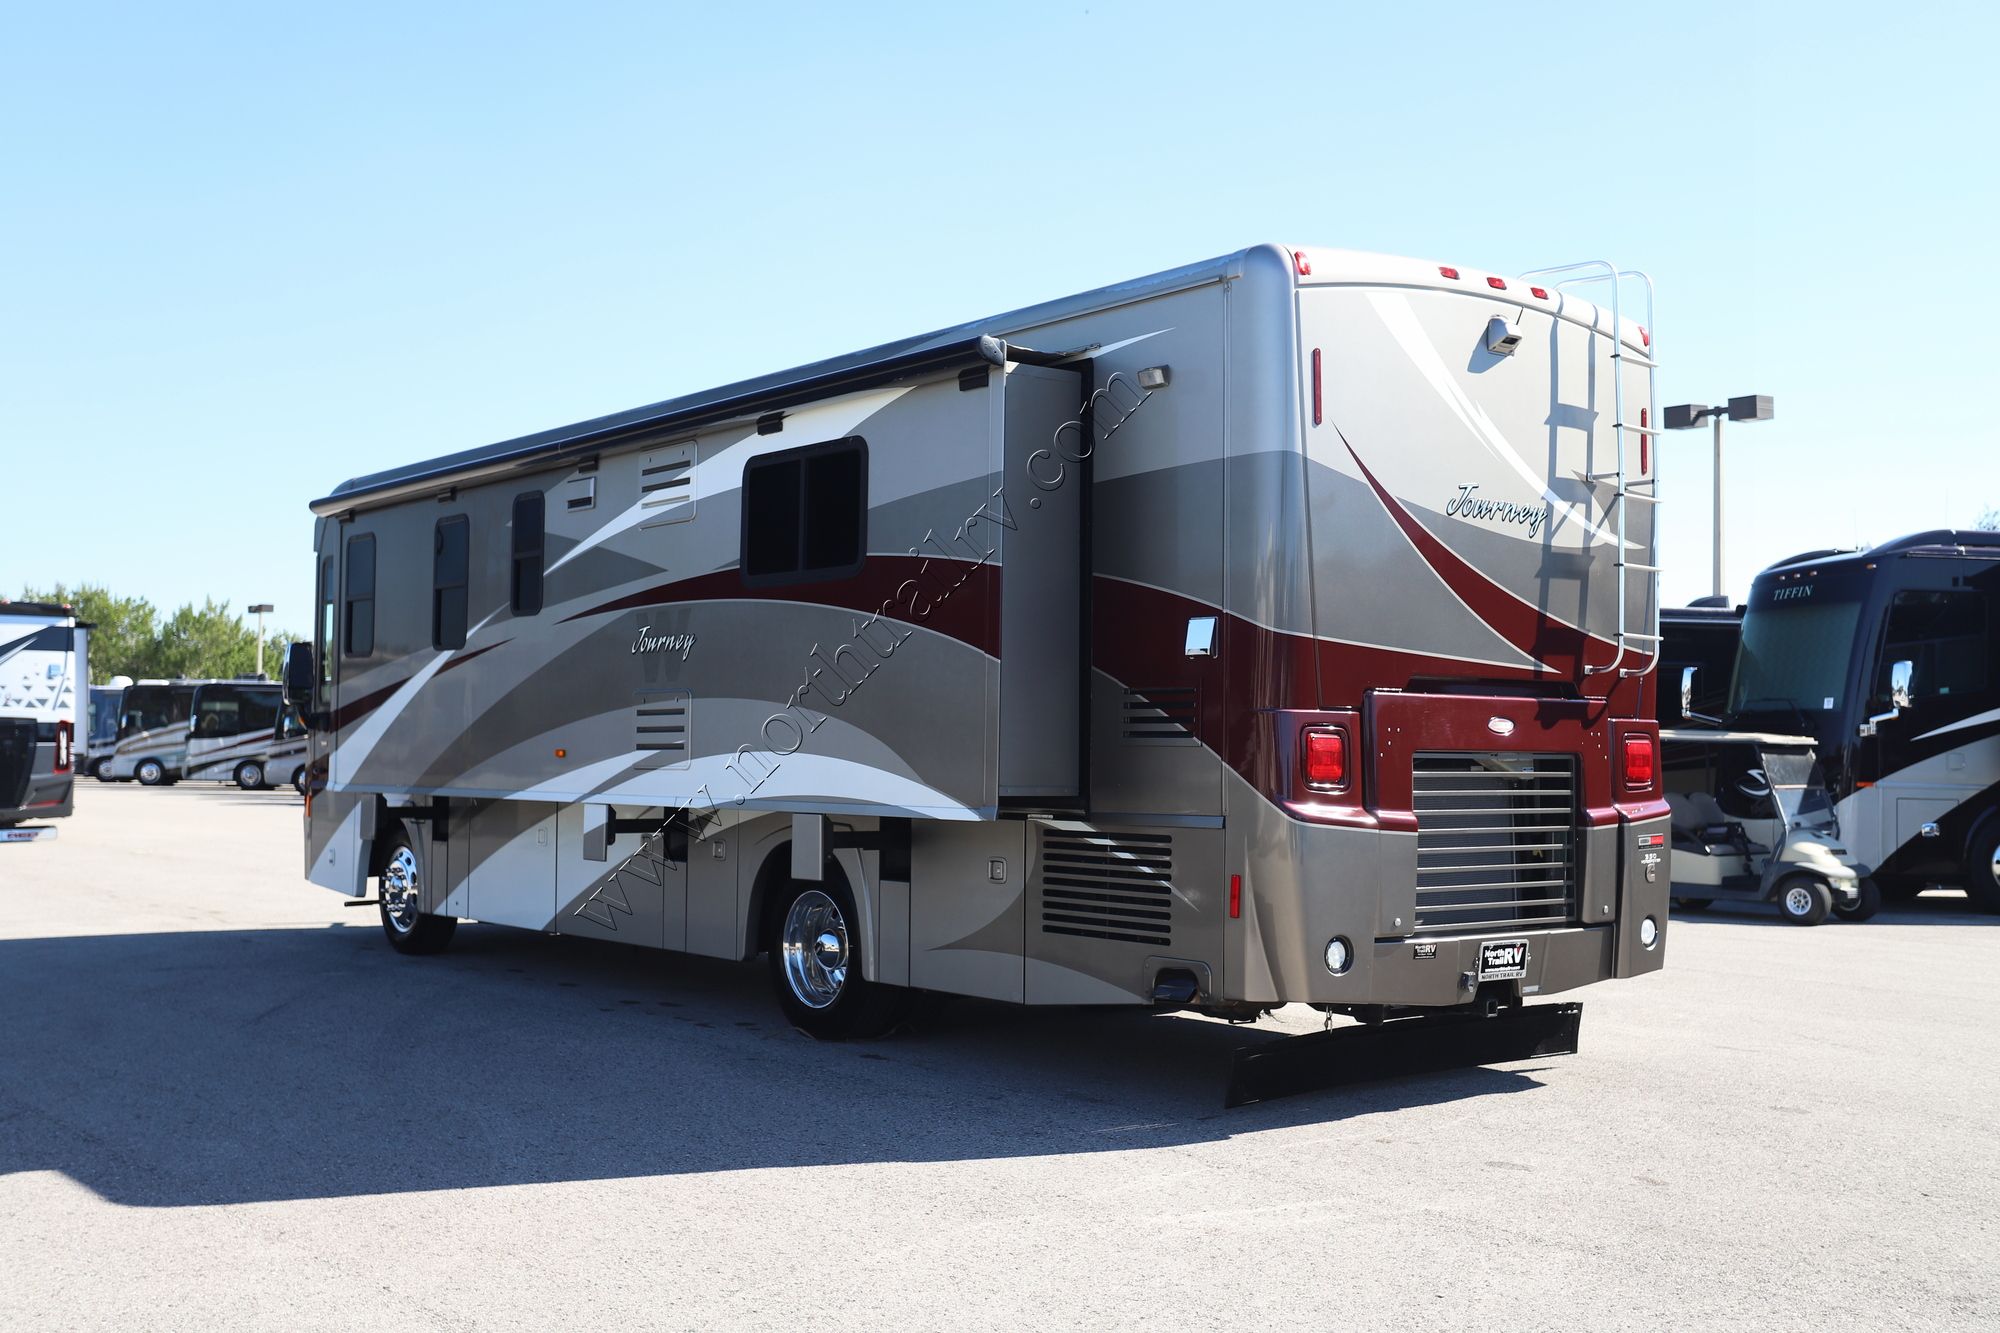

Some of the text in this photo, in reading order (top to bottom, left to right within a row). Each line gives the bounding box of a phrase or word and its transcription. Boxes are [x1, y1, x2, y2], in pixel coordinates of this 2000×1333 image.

[1446, 482, 1548, 538] Journey
[1773, 584, 1813, 601] TIFFIN
[631, 625, 697, 662] Journey
[1425, 944, 1436, 953] RV
[1484, 949, 1504, 958] North
[1504, 947, 1524, 965] RV
[1487, 956, 1504, 966] Trail
